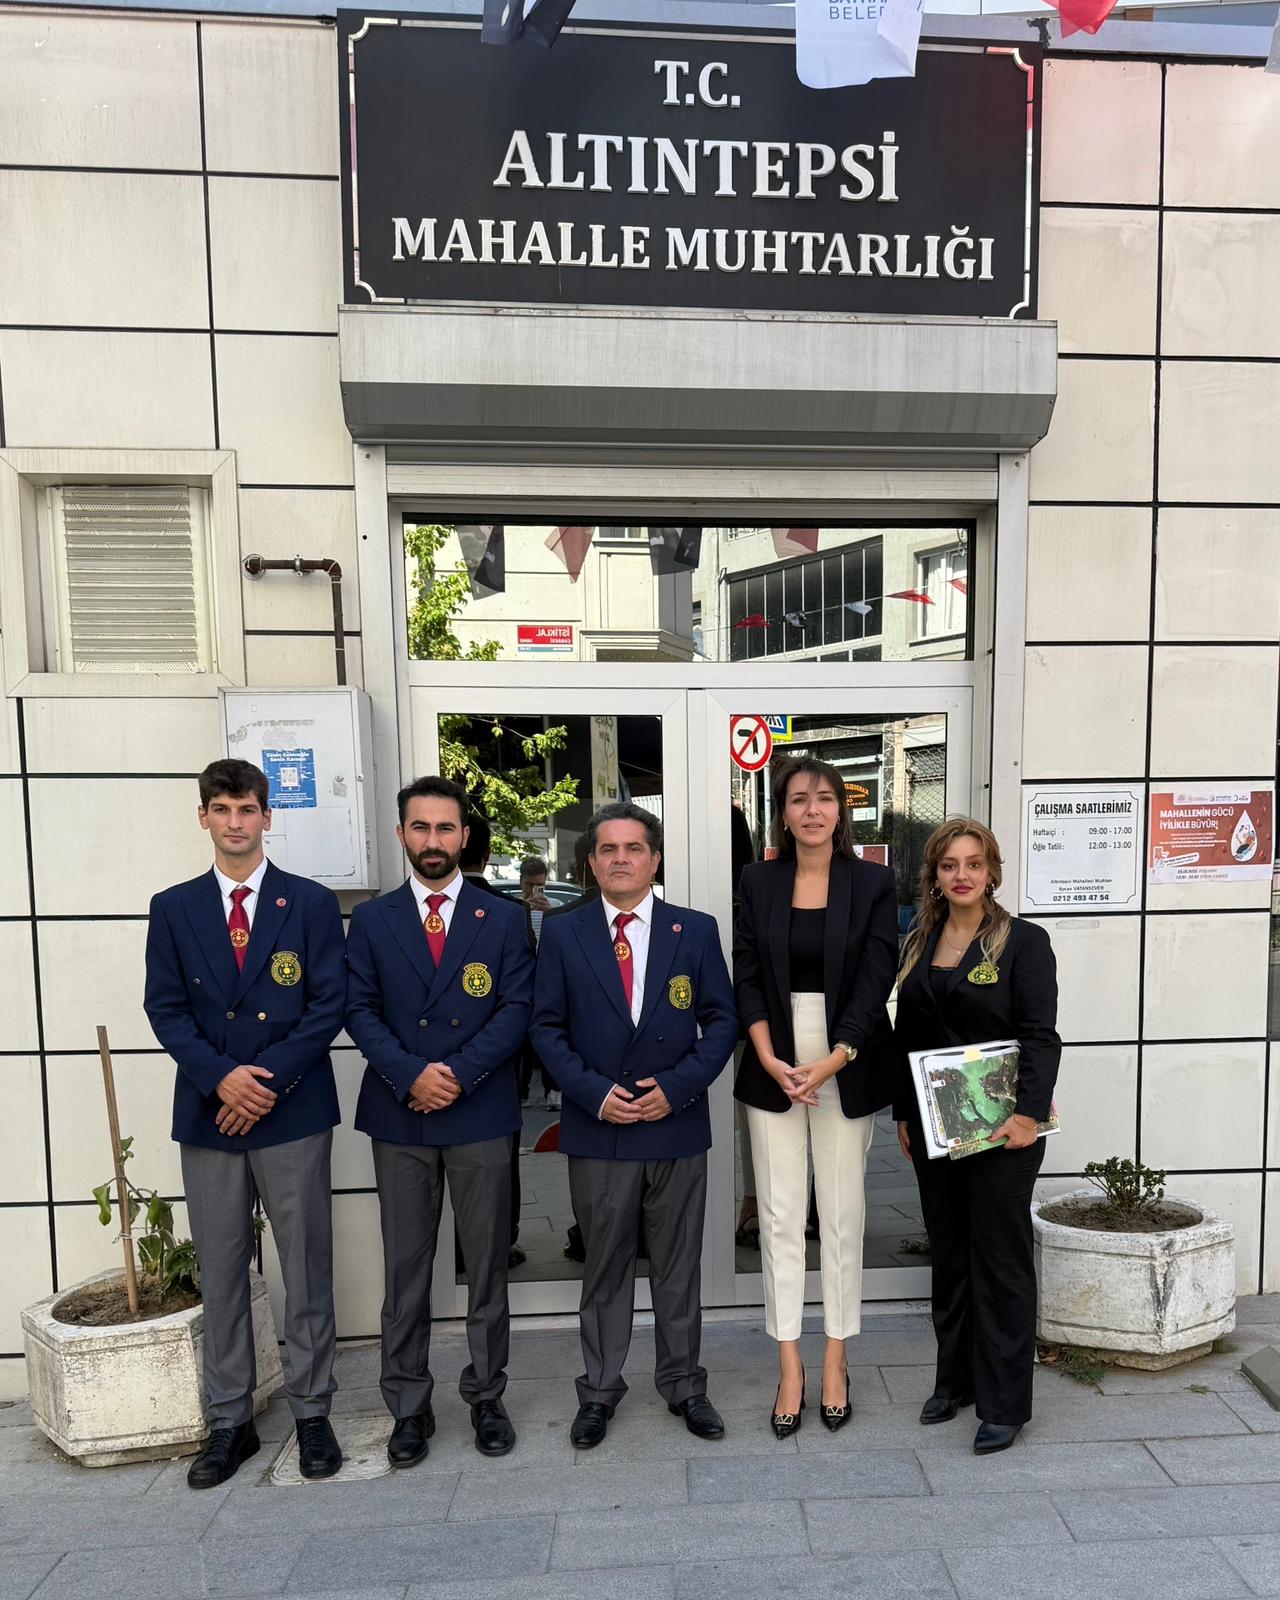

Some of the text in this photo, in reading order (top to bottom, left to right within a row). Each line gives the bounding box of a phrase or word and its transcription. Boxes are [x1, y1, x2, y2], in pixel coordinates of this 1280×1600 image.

[653, 59, 741, 108] T.C.
[492, 129, 900, 203] ALTINTEPSİ
[392, 217, 995, 282] MAHALLE MUHTARLIĞI
[1034, 799, 1132, 817] ÇALIŞMA SAATLERİMİZ
[1160, 807, 1234, 818] MAHALLENİN GÜCÜ
[1160, 819, 1219, 830] İYİLİKLE BÜYÜR!
